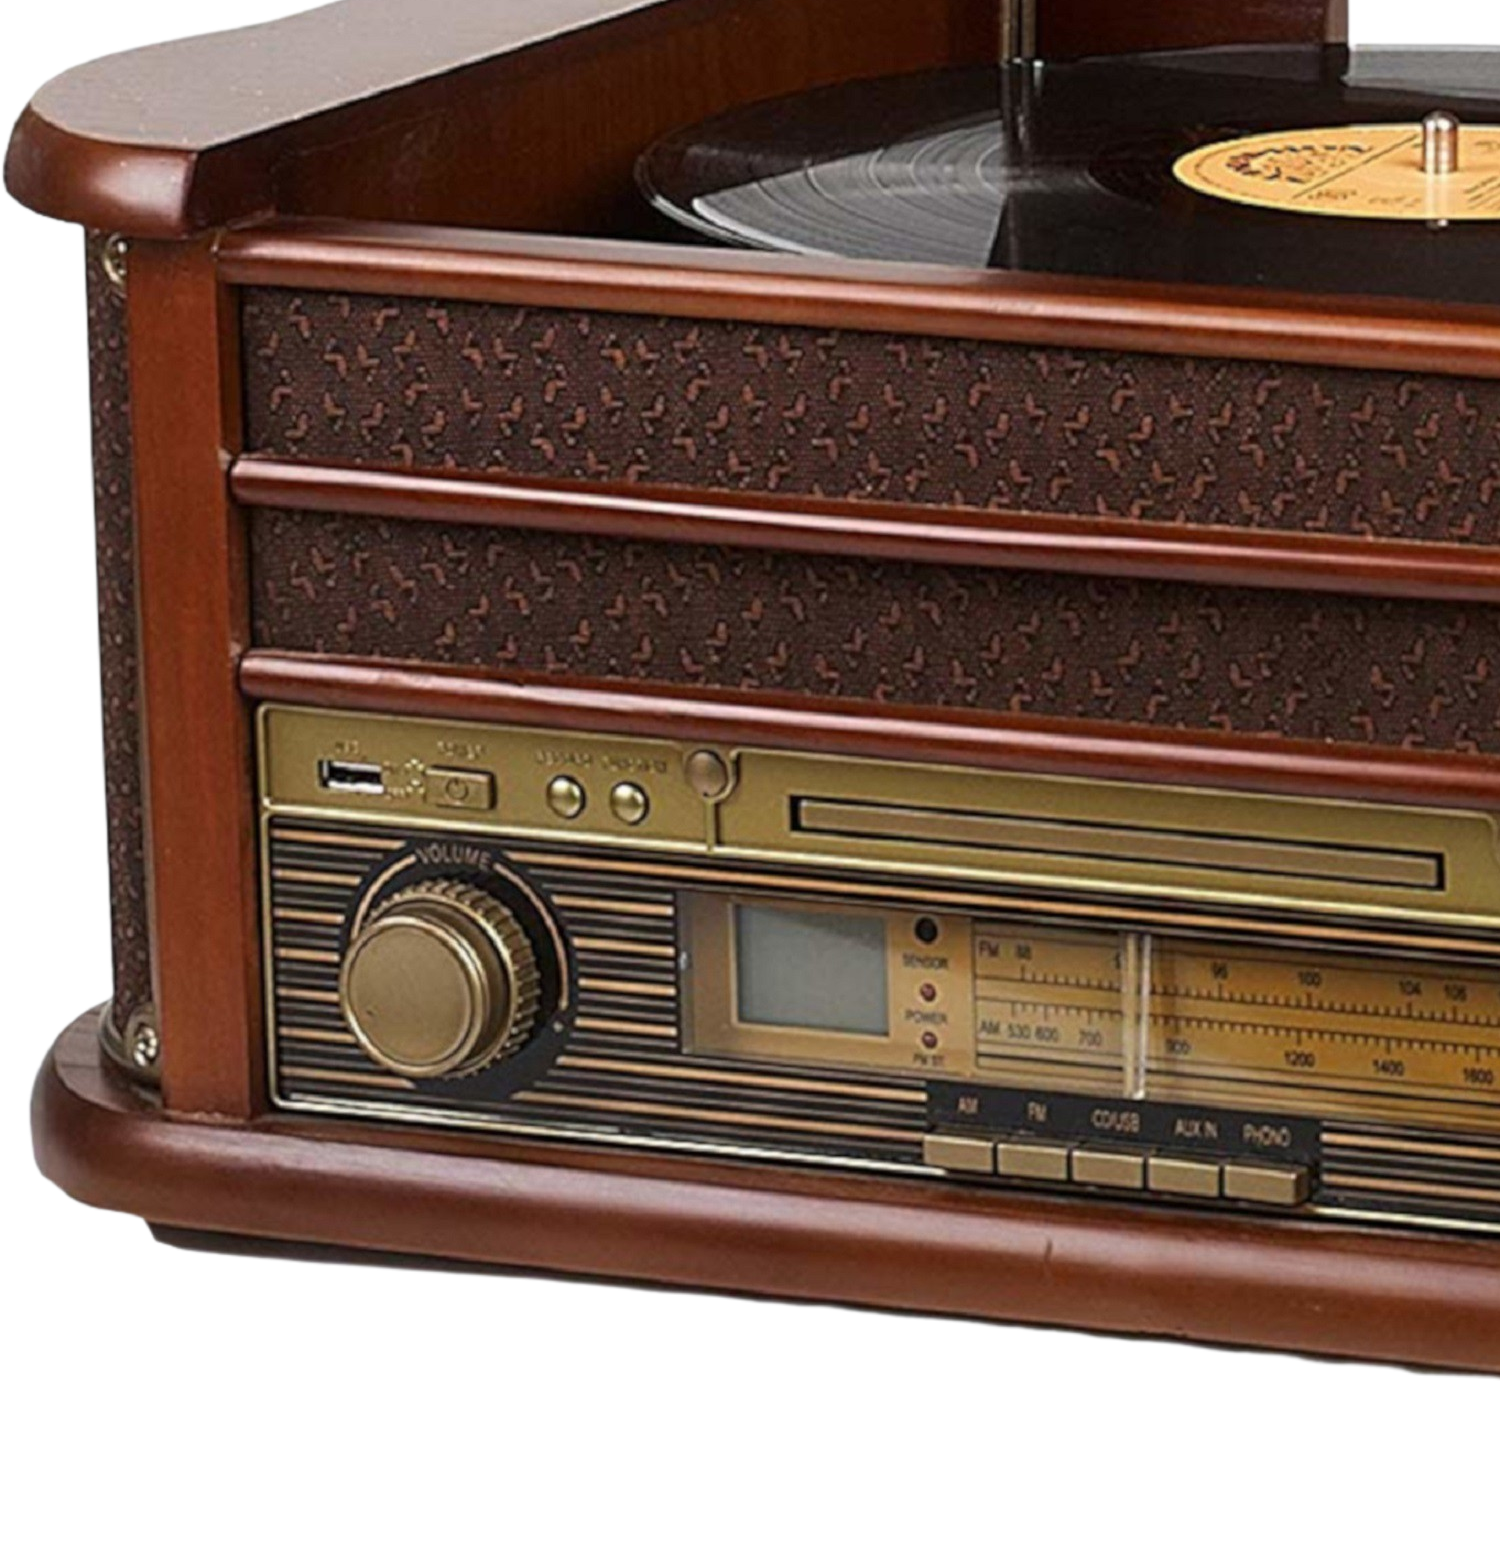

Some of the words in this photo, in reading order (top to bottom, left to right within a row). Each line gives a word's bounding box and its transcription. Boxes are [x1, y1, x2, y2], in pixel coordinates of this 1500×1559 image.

[415, 842, 492, 872] VOLUME
[902, 952, 948, 970] SENSOR
[979, 941, 999, 958] FM
[1016, 944, 1032, 961] 88
[1298, 970, 1323, 987] 100
[1399, 979, 1422, 997] 104
[904, 1008, 947, 1025] POWER
[980, 1020, 1000, 1035] AM
[1007, 1023, 1032, 1040] 530
[1036, 1026, 1059, 1041] 600
[1078, 1029, 1102, 1046] 700
[1284, 1050, 1316, 1068] 1200
[1372, 1058, 1405, 1077] 1400
[957, 1096, 979, 1115] AM
[1028, 1100, 1048, 1122] FM
[1091, 1108, 1141, 1133] CD/USB
[1174, 1118, 1201, 1138] AUX
[1242, 1123, 1293, 1148] PHONO
